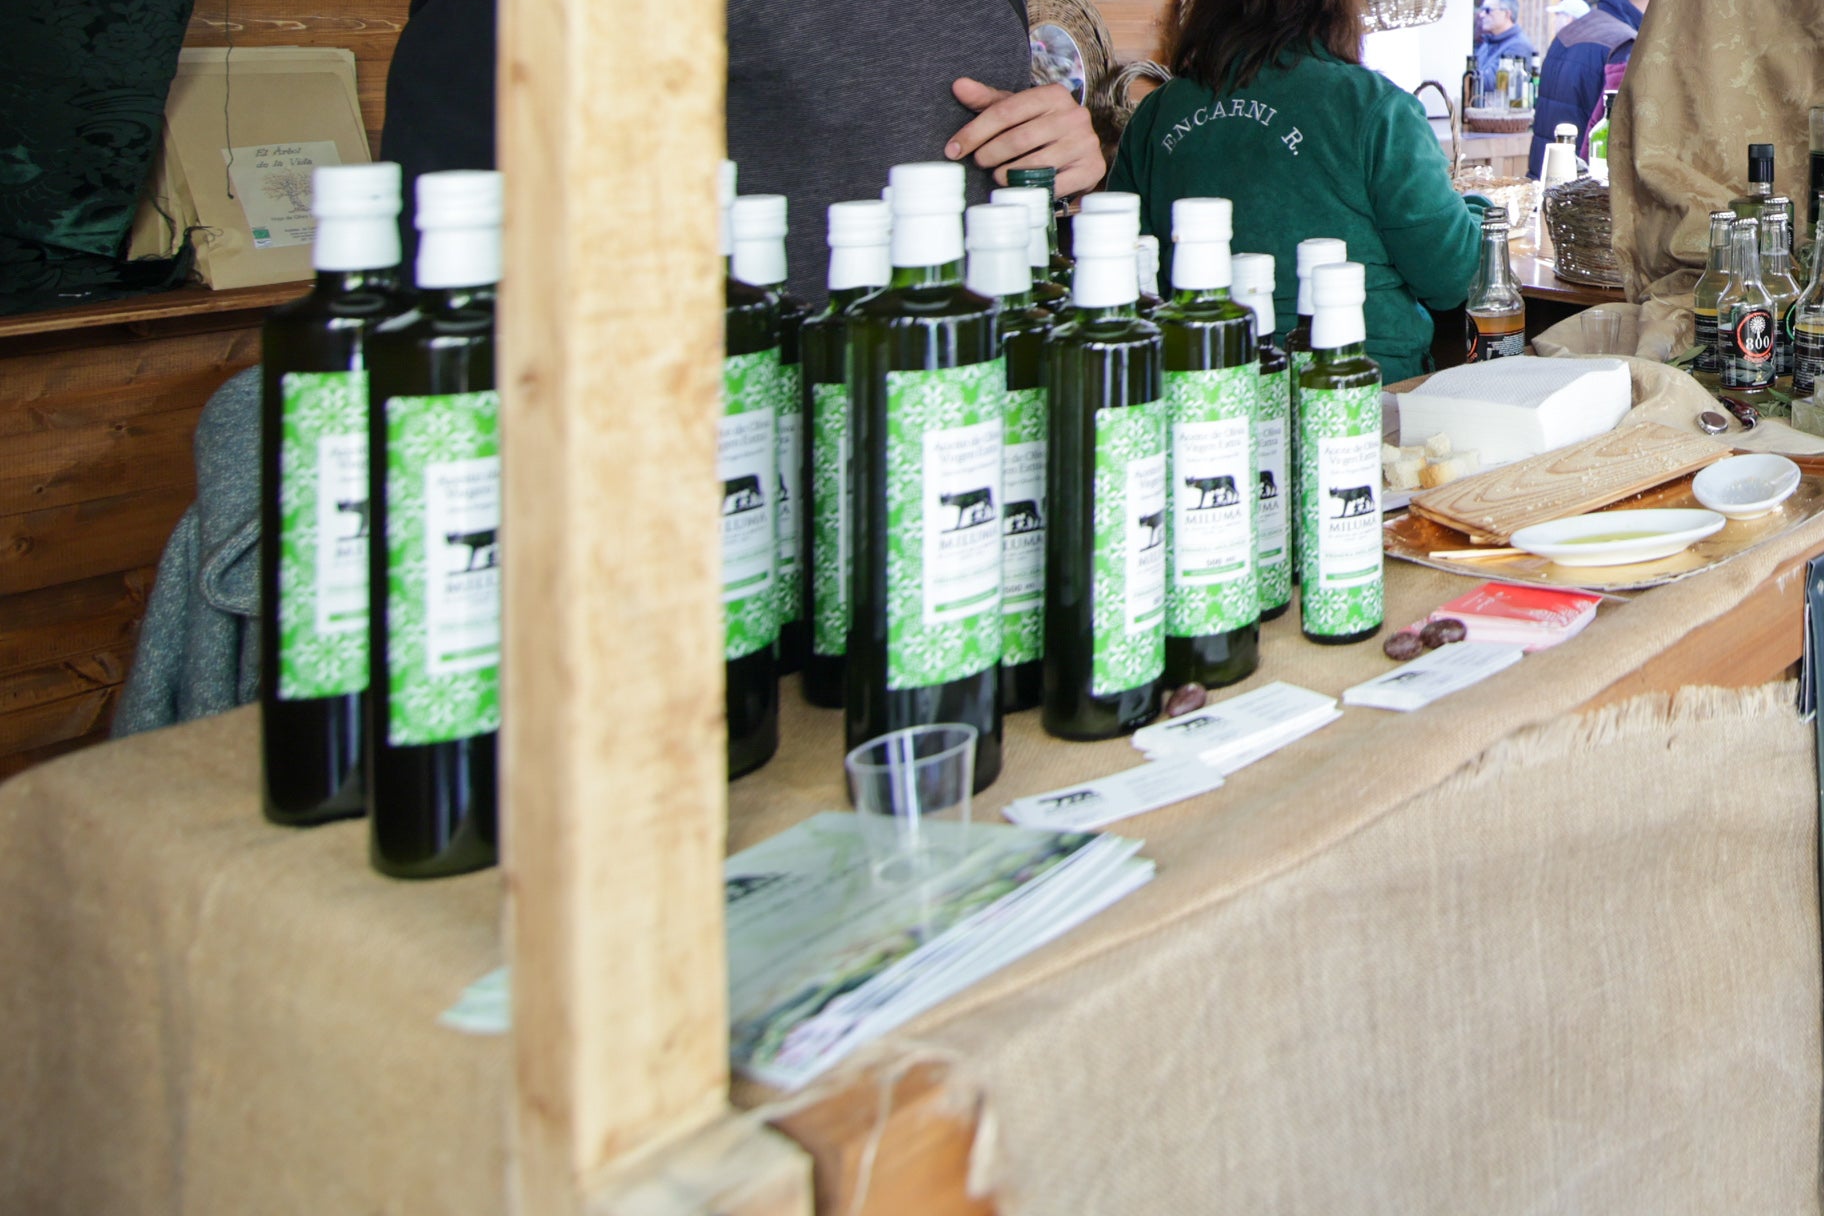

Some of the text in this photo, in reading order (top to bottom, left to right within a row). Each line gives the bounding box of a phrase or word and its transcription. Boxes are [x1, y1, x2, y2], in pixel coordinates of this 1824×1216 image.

[1160, 98, 1305, 157] ENCARNI R.
[256, 160, 269, 169] de
[272, 159, 284, 168] la
[1745, 336, 1770, 351] 800
[1185, 508, 1243, 526] MILUMA
[1329, 516, 1378, 534] MILUMA
